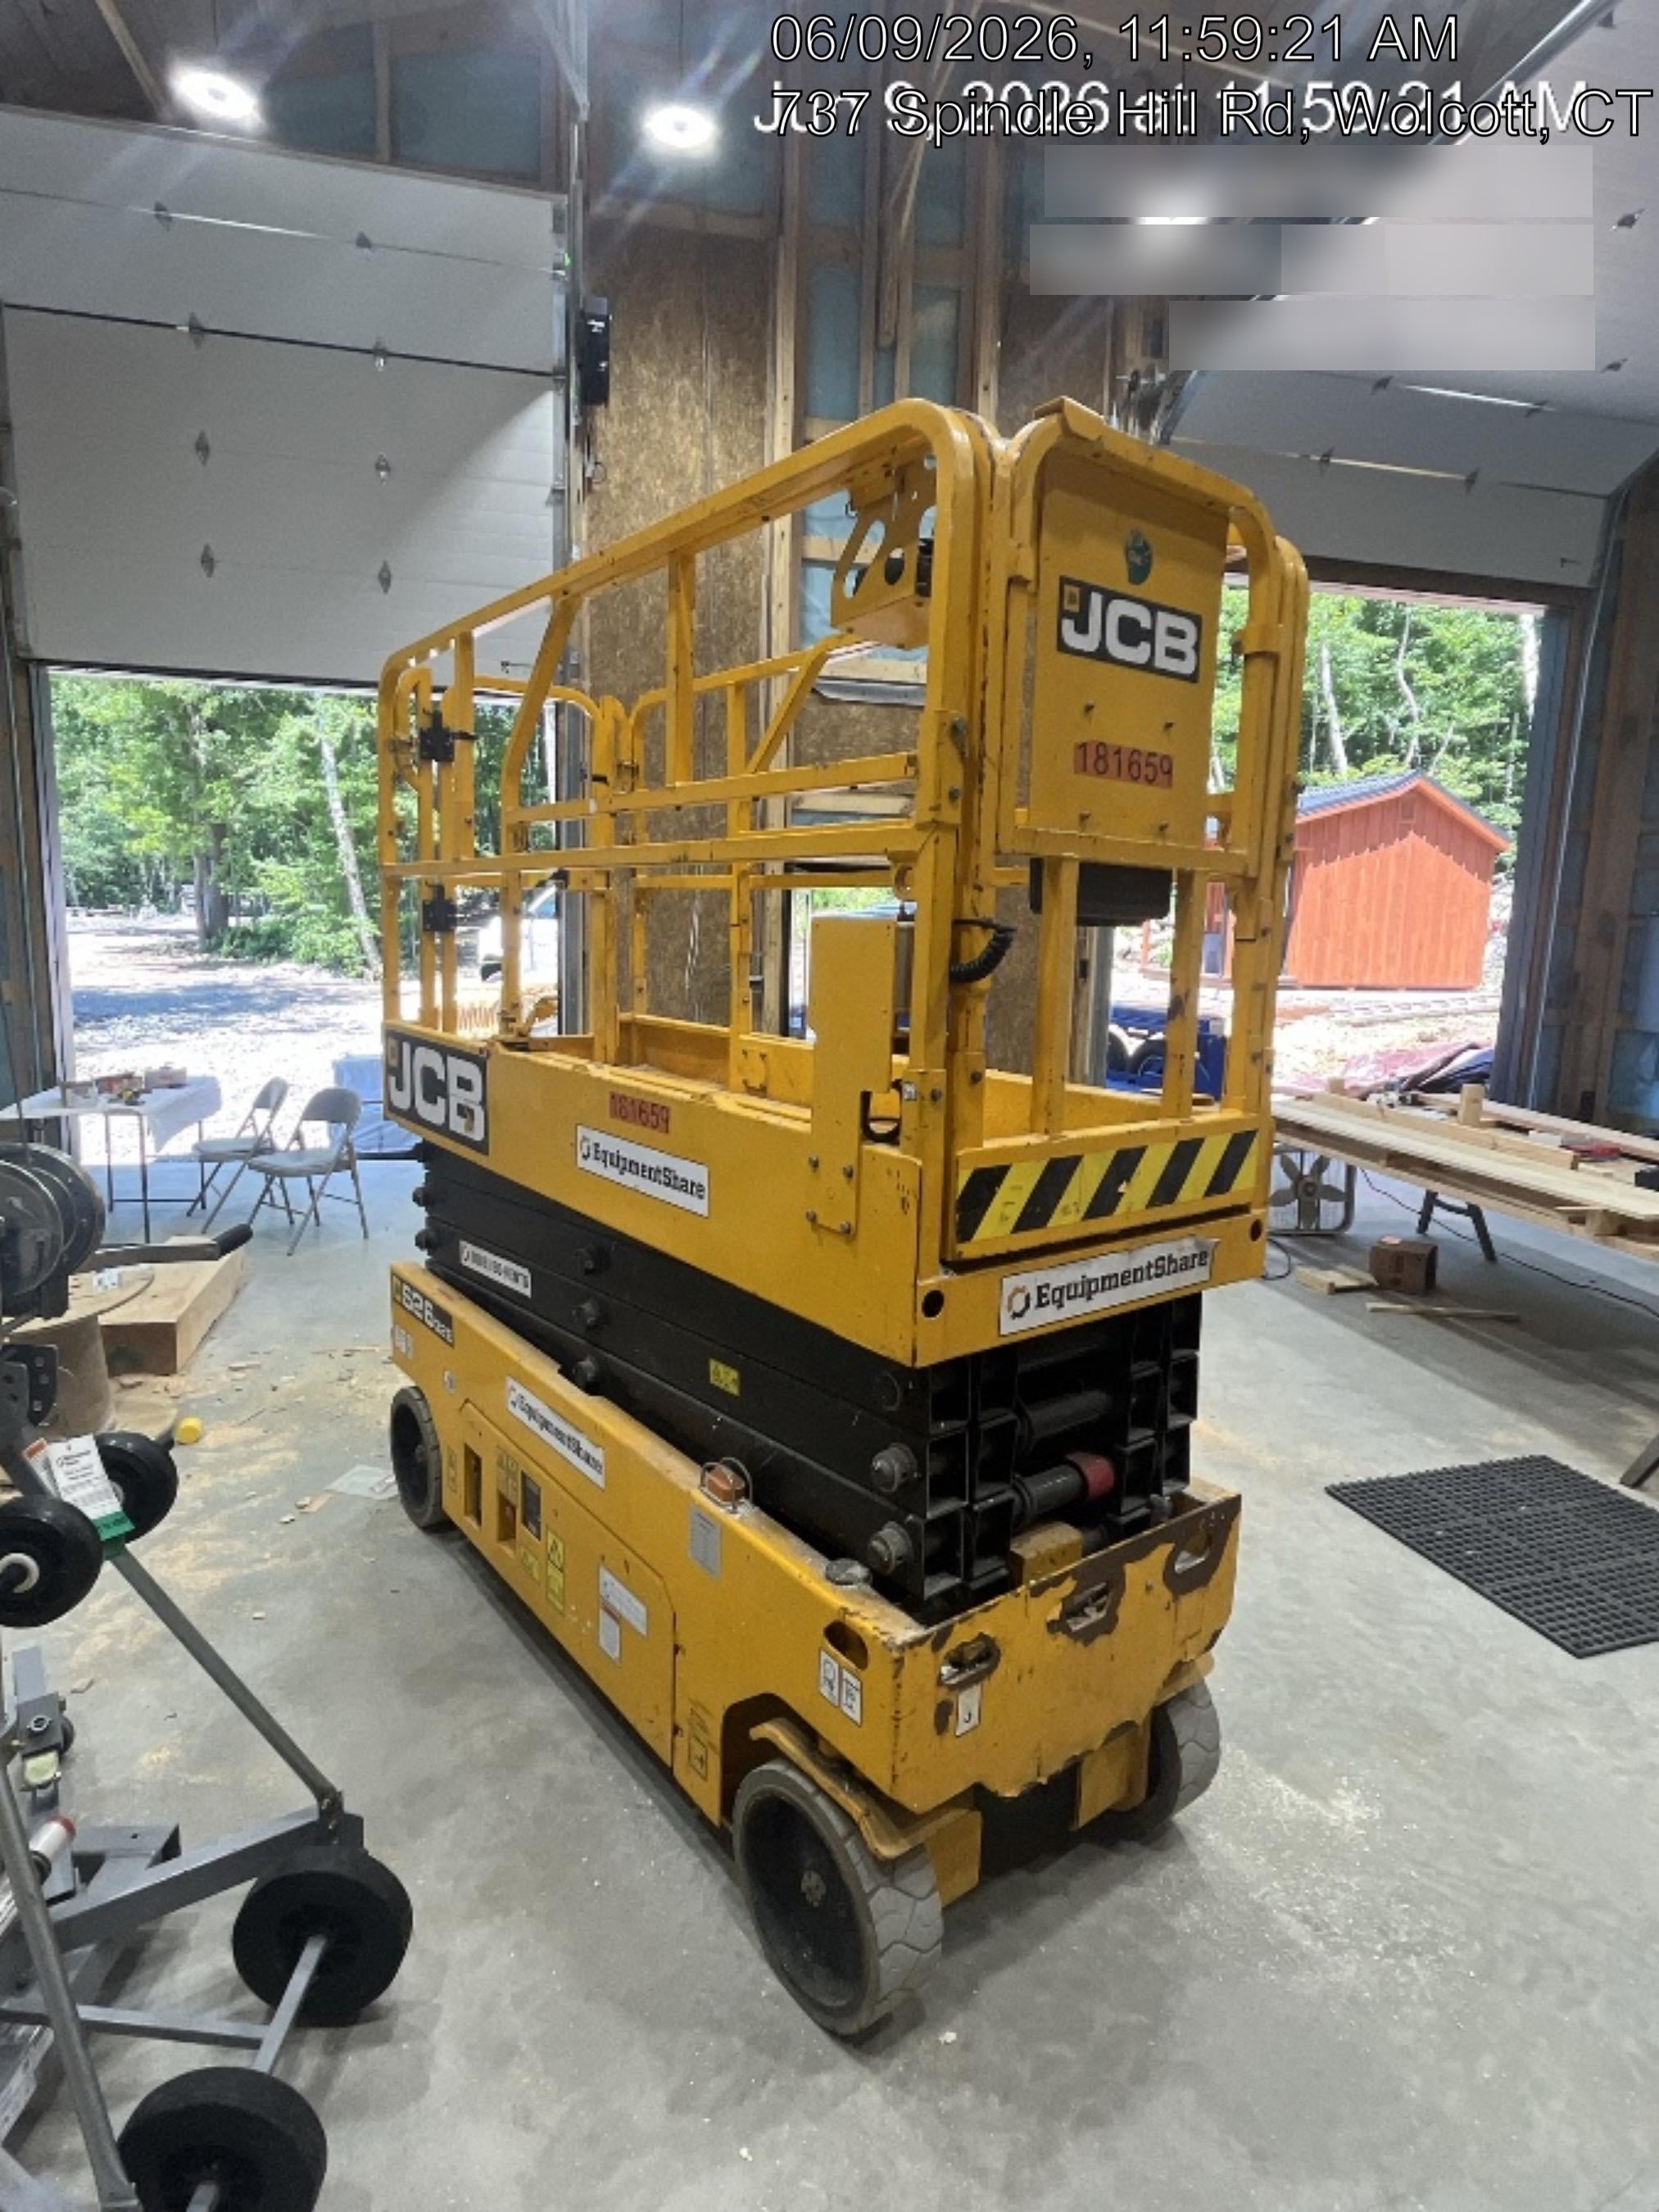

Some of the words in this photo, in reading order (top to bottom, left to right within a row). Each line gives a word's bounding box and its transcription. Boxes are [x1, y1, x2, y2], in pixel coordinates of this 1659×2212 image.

[1061, 592, 1198, 674] JCB
[1077, 741, 1173, 786] 181659
[389, 1040, 485, 1142] JCB
[610, 1091, 669, 1135] 181659
[593, 1142, 705, 1199] EquipmentShare
[1035, 1249, 1208, 1310] EquipmentShare
